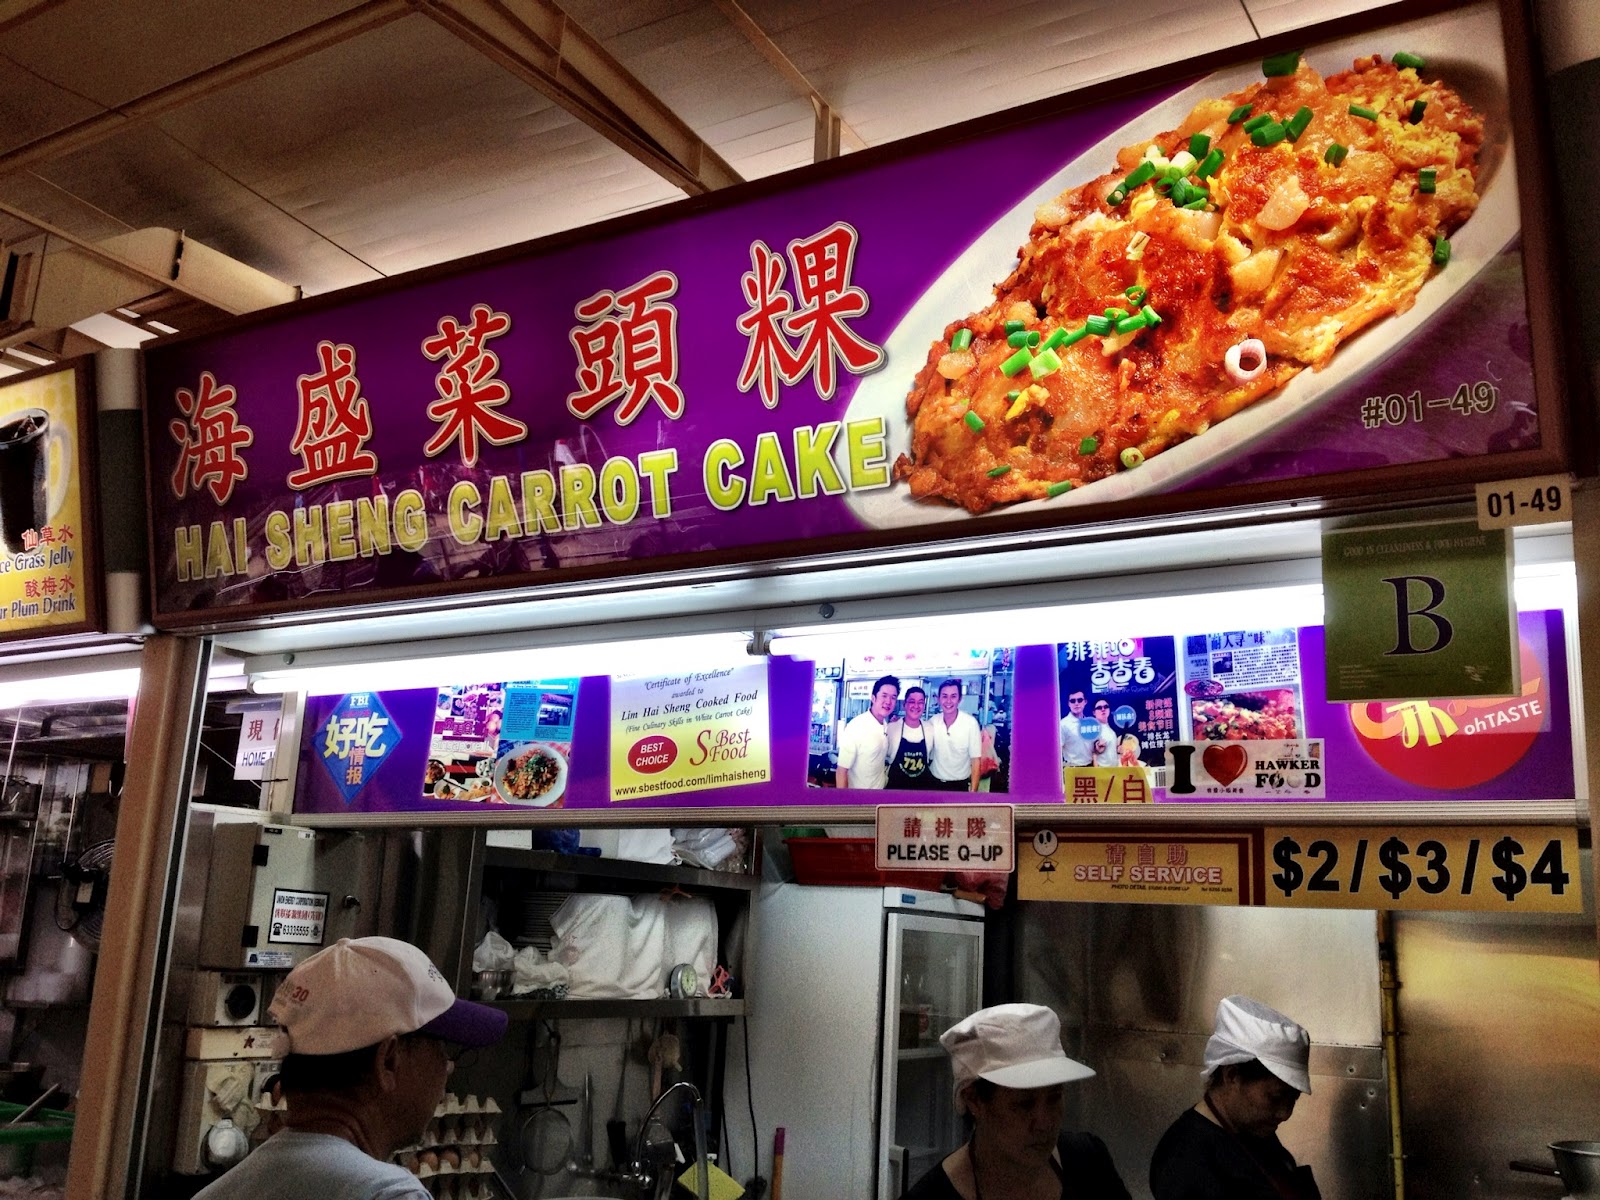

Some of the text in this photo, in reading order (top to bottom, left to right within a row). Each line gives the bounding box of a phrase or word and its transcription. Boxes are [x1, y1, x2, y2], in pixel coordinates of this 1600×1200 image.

[1361, 381, 1496, 428] #01-49
[174, 416, 891, 582] HAI SHENG CARROT CAKE
[1487, 486, 1562, 517] 01-49
[22, 524, 74, 551] 仙草水
[14, 553, 46, 571] Grass
[48, 545, 75, 569] Jelly
[25, 574, 75, 598] 酸梅水
[12, 599, 39, 618] Plum
[43, 592, 75, 614] Drink
[1382, 576, 1454, 657] B
[684, 673, 692, 685] of
[350, 695, 370, 707] FBI
[621, 690, 758, 721] Lim Hai Sheng Cooked Food
[671, 689, 695, 699] awarded
[642, 721, 666, 731] Culinary
[668, 717, 684, 727] Skills
[695, 713, 713, 722] White
[715, 711, 733, 720] Carrot
[1464, 700, 1543, 736] ohTASTE
[323, 712, 389, 759] 好吃
[716, 728, 751, 747] Best
[242, 752, 266, 766] HOME
[641, 742, 664, 754] BEST
[709, 743, 748, 763] Food
[635, 754, 669, 767] CHOICE
[1169, 745, 1320, 794] I HAWKER
[615, 769, 767, 796] www.sbestfood.com/limhaisheng
[1072, 774, 1146, 803] 黑/白
[904, 817, 986, 839] 請排隊
[887, 844, 1003, 861] PLEASE Q-UP
[1106, 844, 1188, 865] 请自助
[1074, 865, 1222, 884] SELF SERVICE
